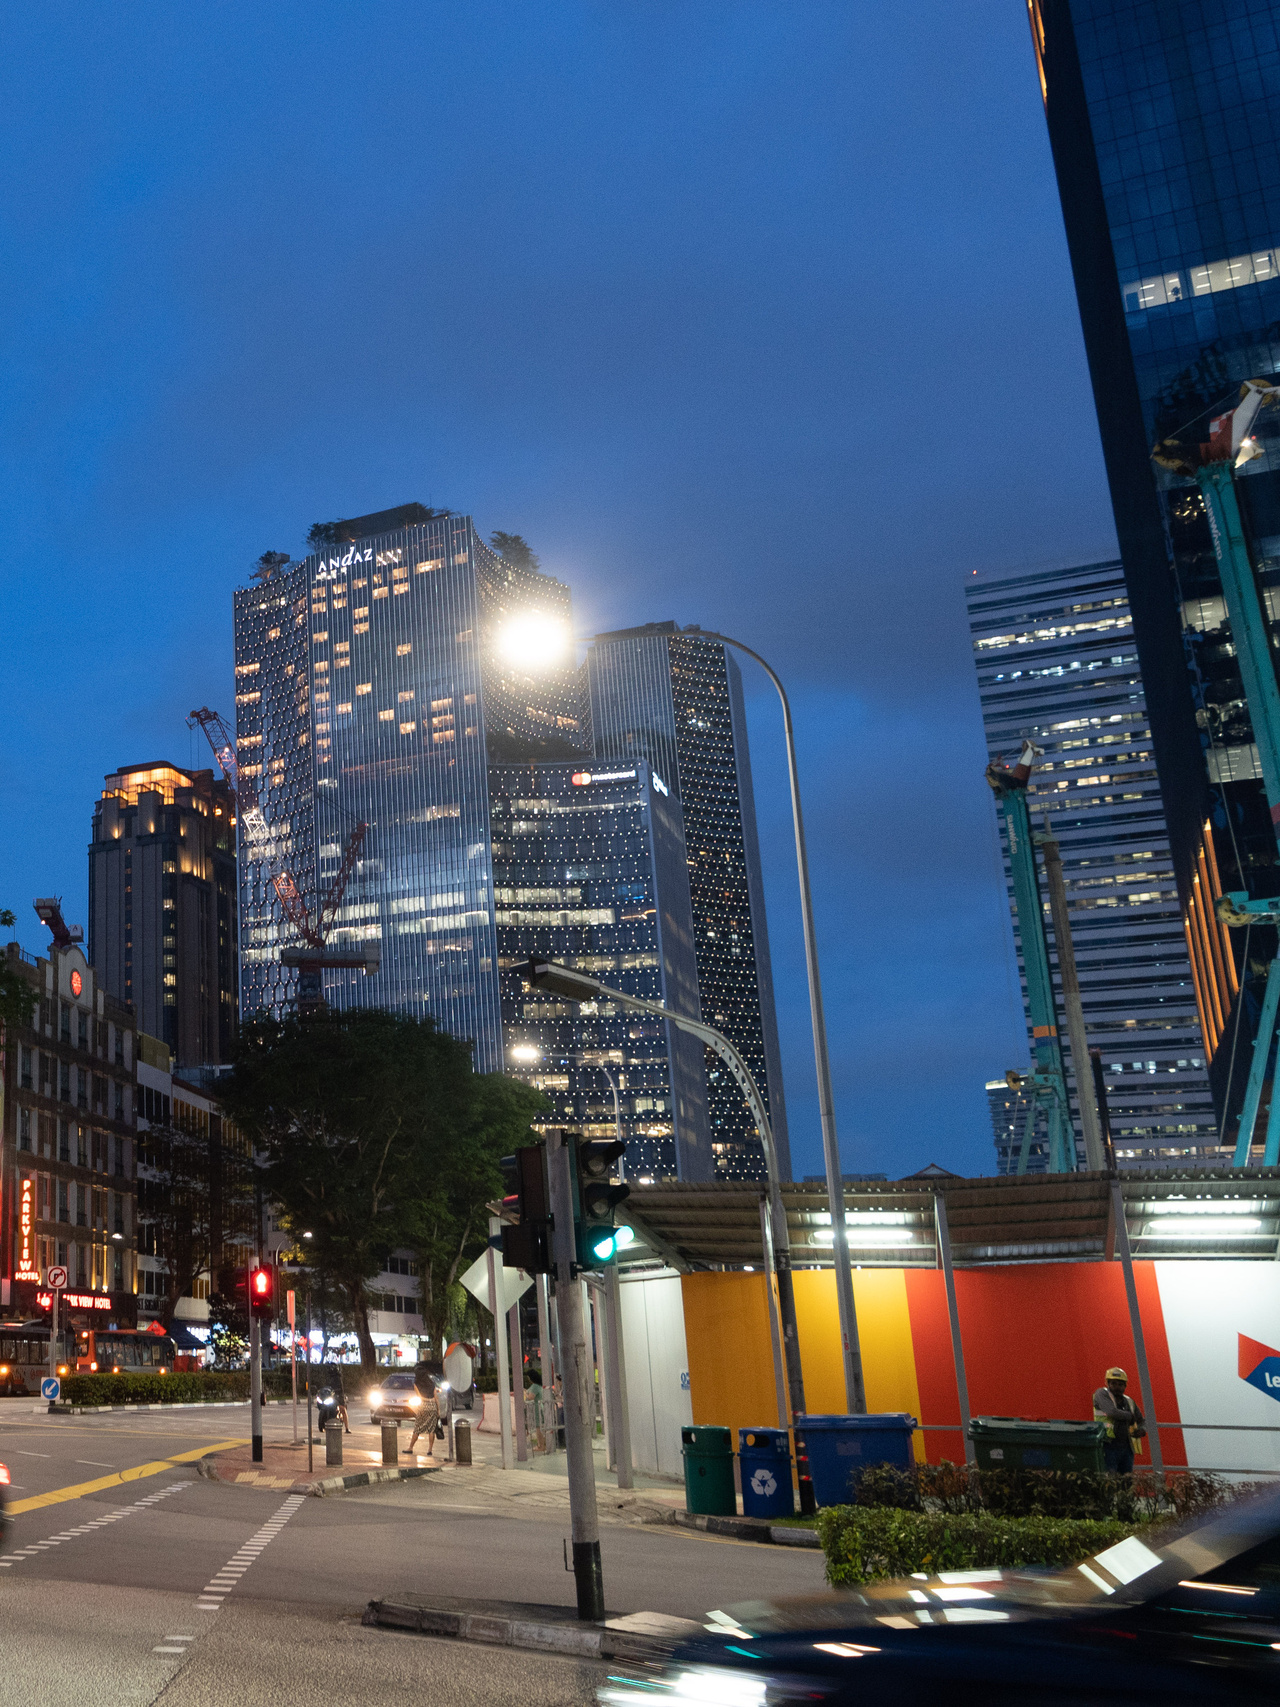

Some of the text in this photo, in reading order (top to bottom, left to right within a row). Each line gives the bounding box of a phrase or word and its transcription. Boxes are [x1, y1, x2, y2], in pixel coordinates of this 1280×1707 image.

[1205, 493, 1222, 560] SUNWARD
[1006, 814, 1019, 855] SUNWARD
[19, 1180, 32, 1271] PARKVIEW
[15, 1272, 39, 1280] HOTEL
[78, 1295, 93, 1308] VIEW
[94, 1297, 111, 1310] HOTEL
